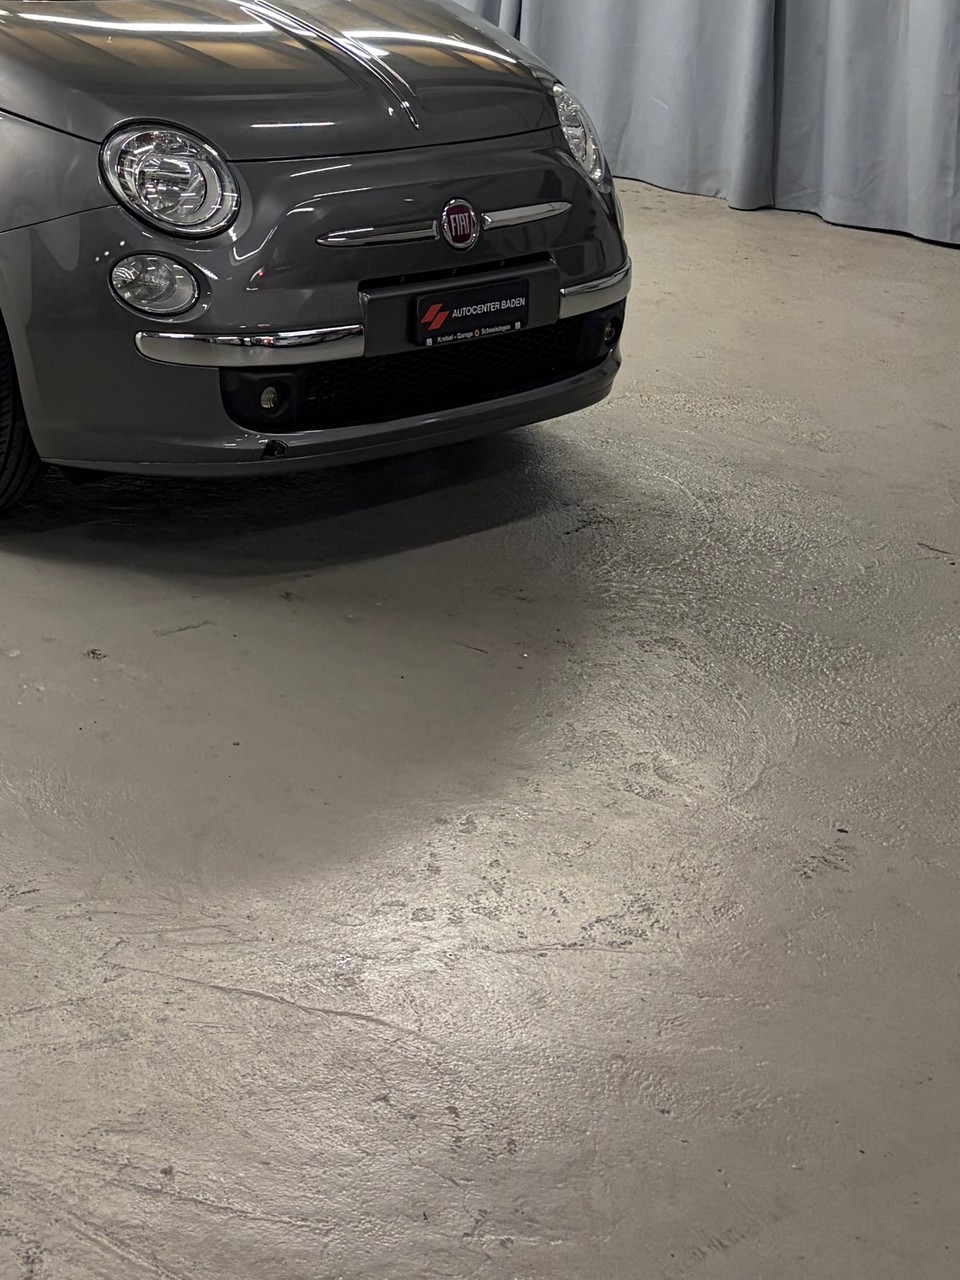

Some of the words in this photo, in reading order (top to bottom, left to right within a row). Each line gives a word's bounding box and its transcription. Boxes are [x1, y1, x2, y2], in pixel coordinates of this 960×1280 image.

[450, 213, 470, 236] FIAT
[452, 301, 500, 318] AUTOCENTER
[501, 297, 525, 309] BADEN
